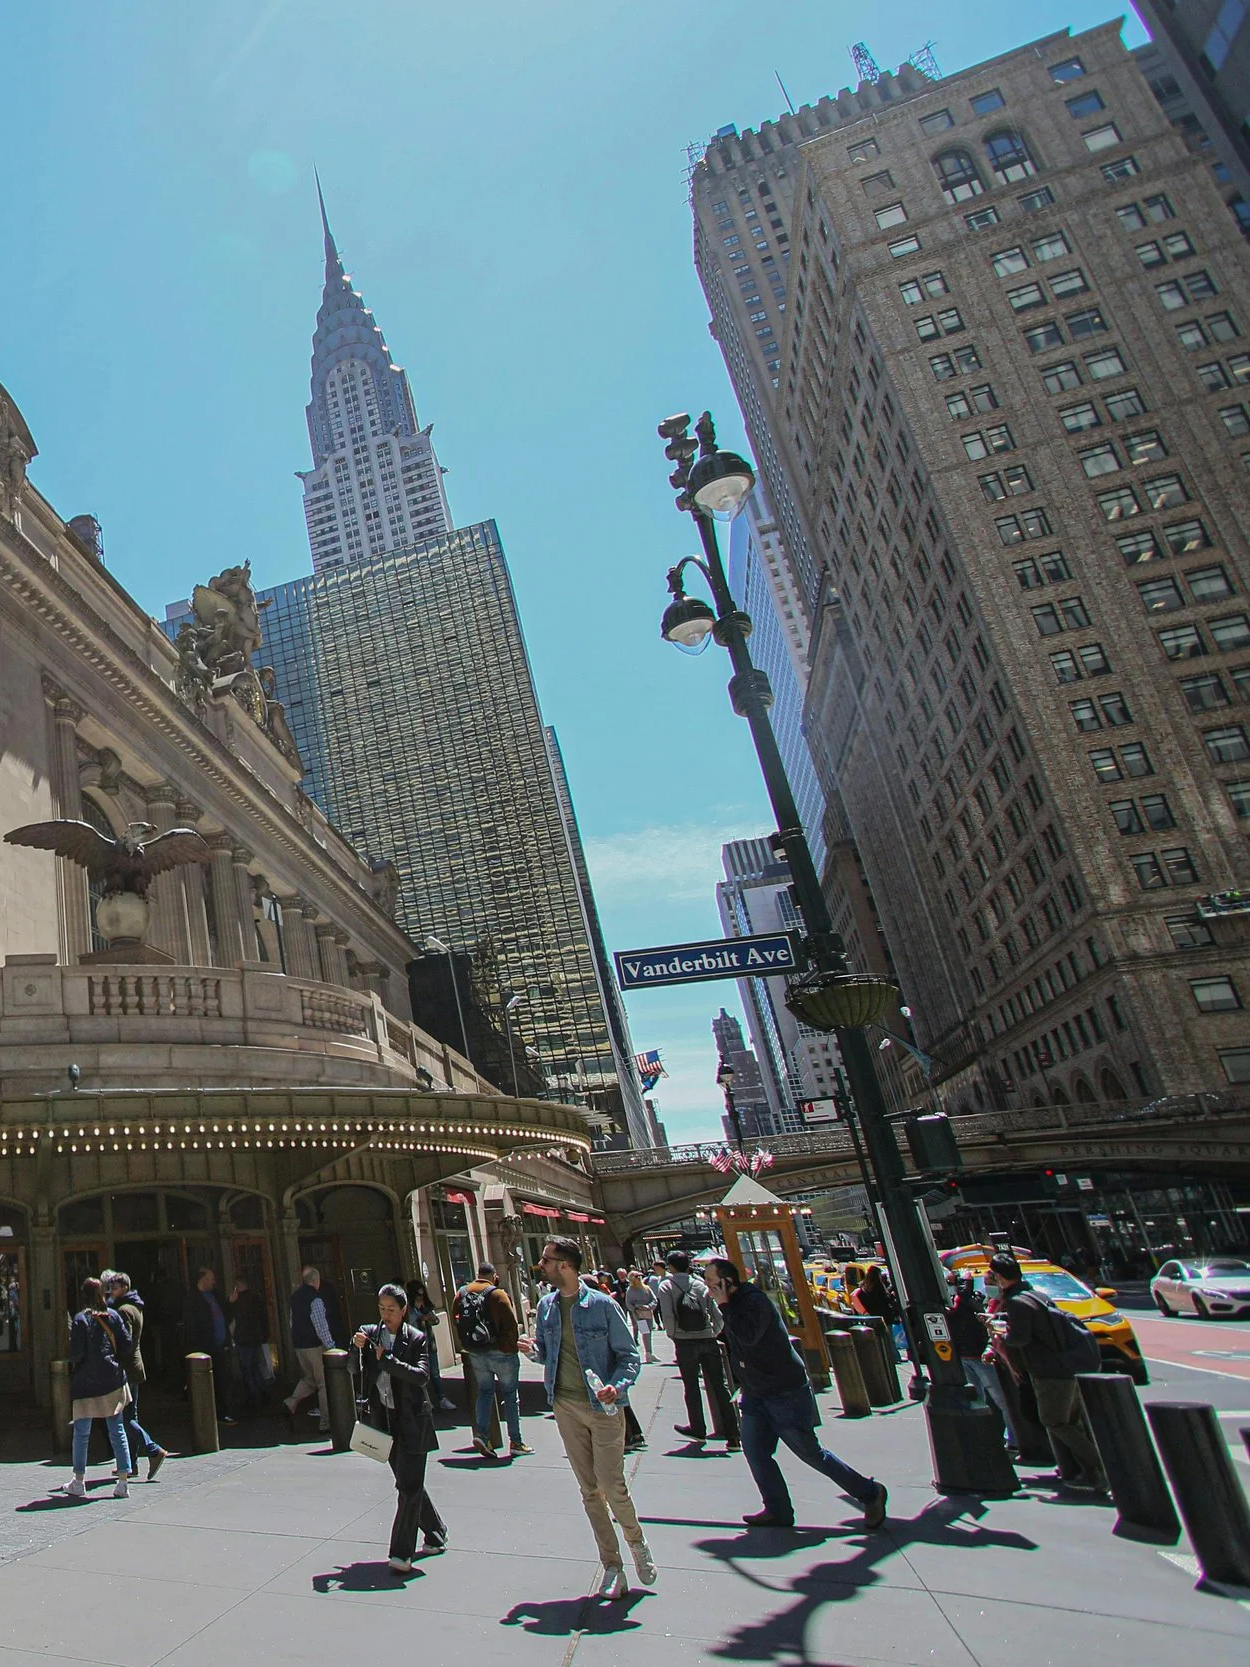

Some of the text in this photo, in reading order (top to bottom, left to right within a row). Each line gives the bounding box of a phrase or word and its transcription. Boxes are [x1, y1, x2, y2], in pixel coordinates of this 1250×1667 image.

[624, 947, 790, 979] Vanderbilt Ave
[1060, 1143, 1163, 1156] PERSHING
[777, 1167, 850, 1188] CENTRAL
